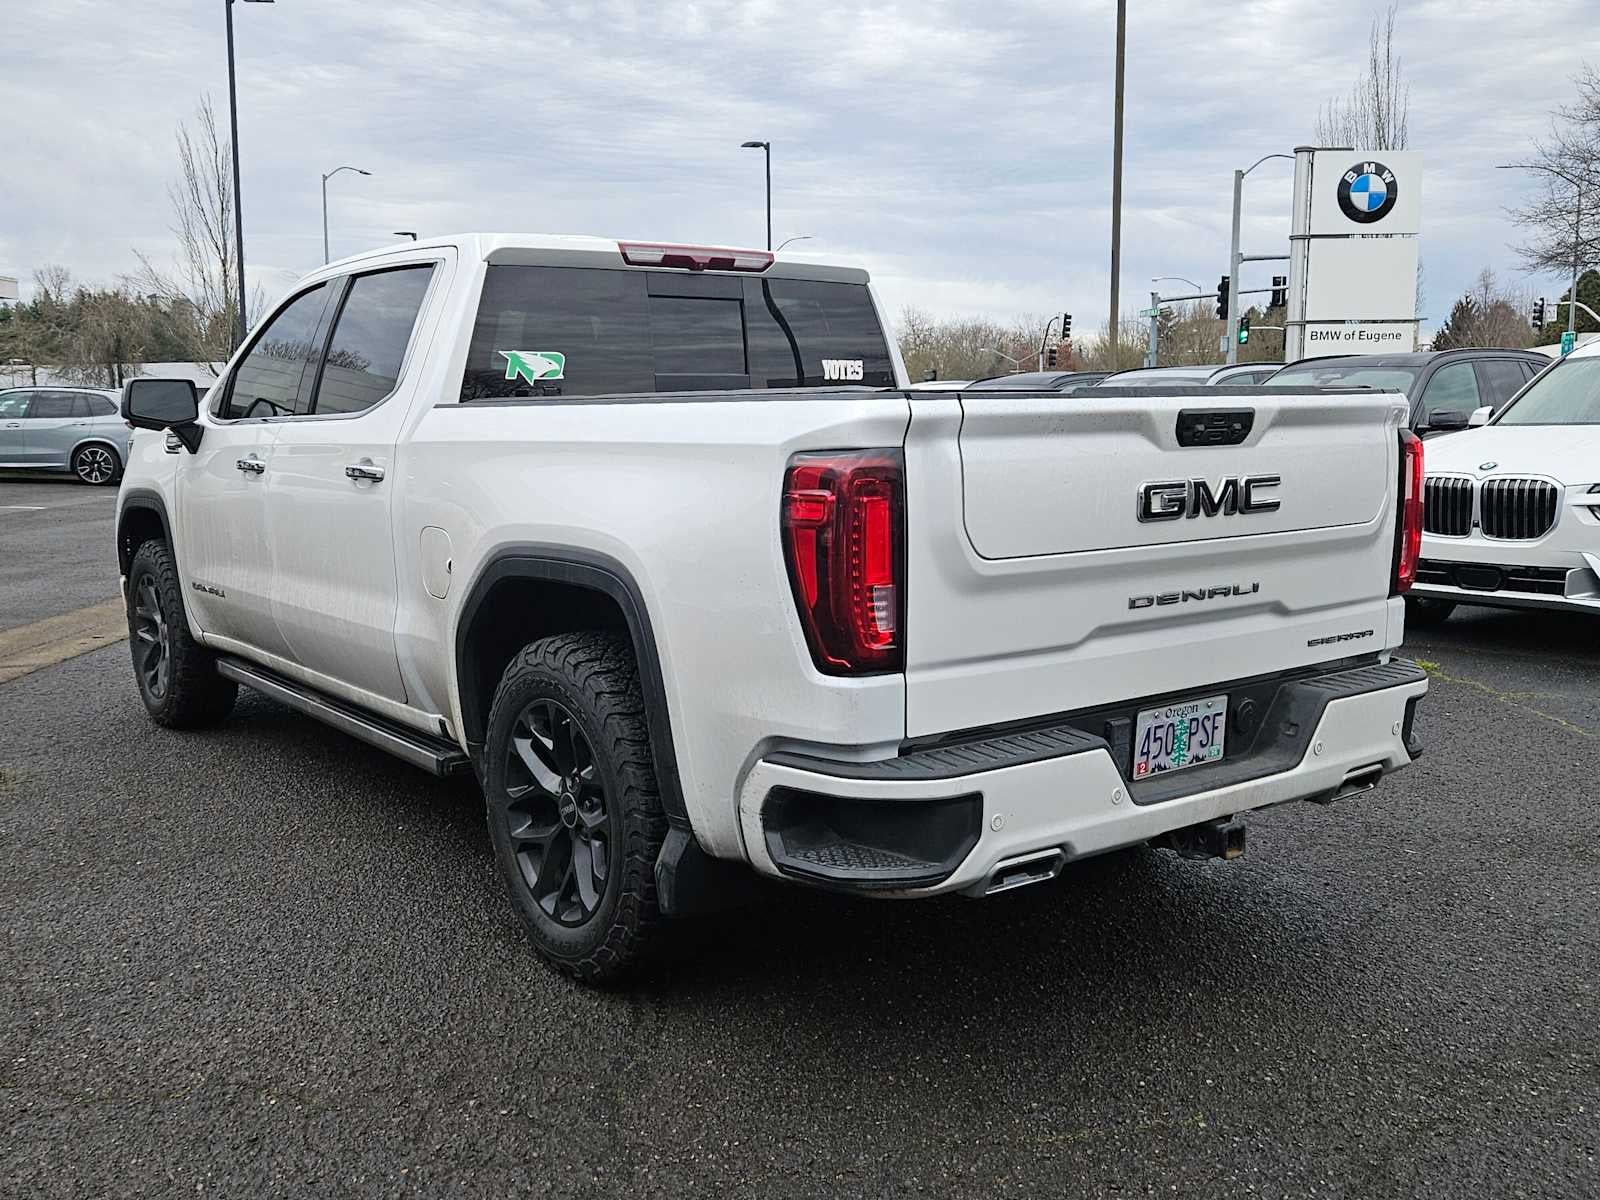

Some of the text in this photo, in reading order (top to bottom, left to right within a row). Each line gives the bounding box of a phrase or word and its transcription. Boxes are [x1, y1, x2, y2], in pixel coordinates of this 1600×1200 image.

[1343, 162, 1395, 184] BMW
[1310, 330, 1402, 343] BMW of Eugene
[821, 359, 864, 381] YOTES
[1136, 473, 1281, 523] GMC
[1128, 582, 1260, 610] DENALI
[1307, 629, 1374, 647] SIERRA
[1165, 704, 1199, 719] Oregon
[1140, 711, 1224, 763] 450 PSF
